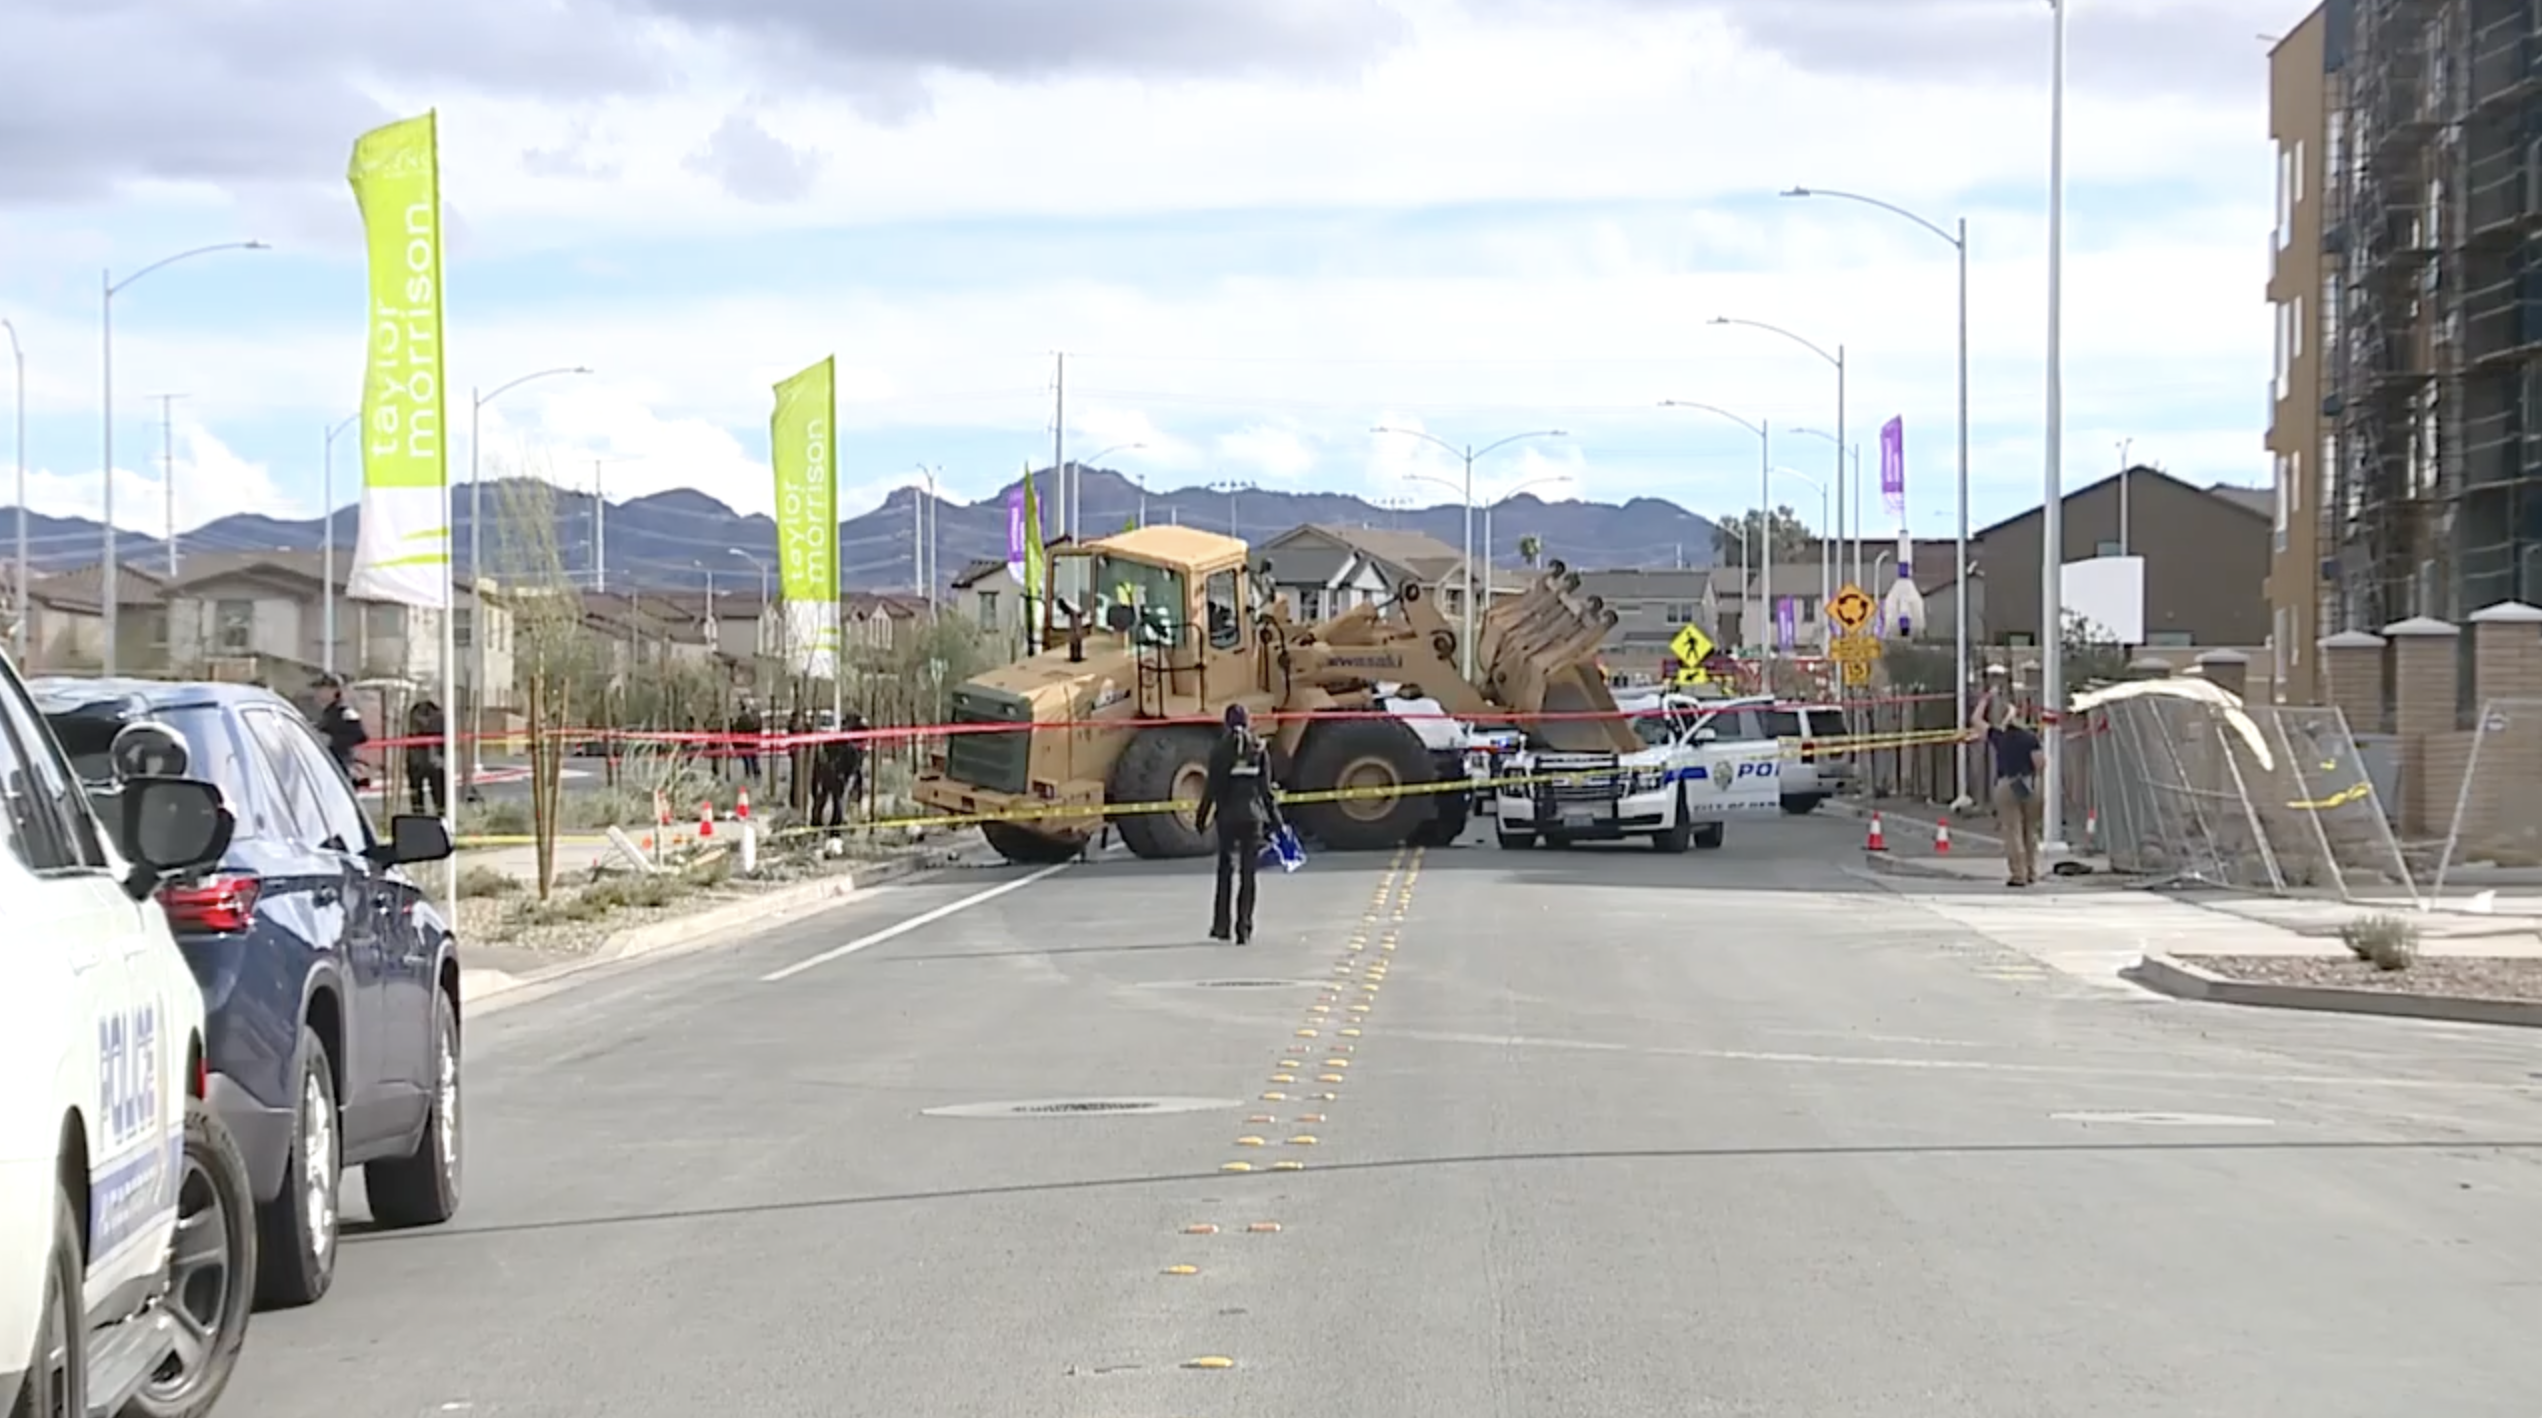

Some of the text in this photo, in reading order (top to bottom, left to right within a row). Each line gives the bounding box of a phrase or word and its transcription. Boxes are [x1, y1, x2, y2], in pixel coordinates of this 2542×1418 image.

[371, 297, 408, 459] taylor
[402, 203, 434, 458] morrison
[784, 478, 805, 582] taylor
[800, 418, 825, 583] morrison
